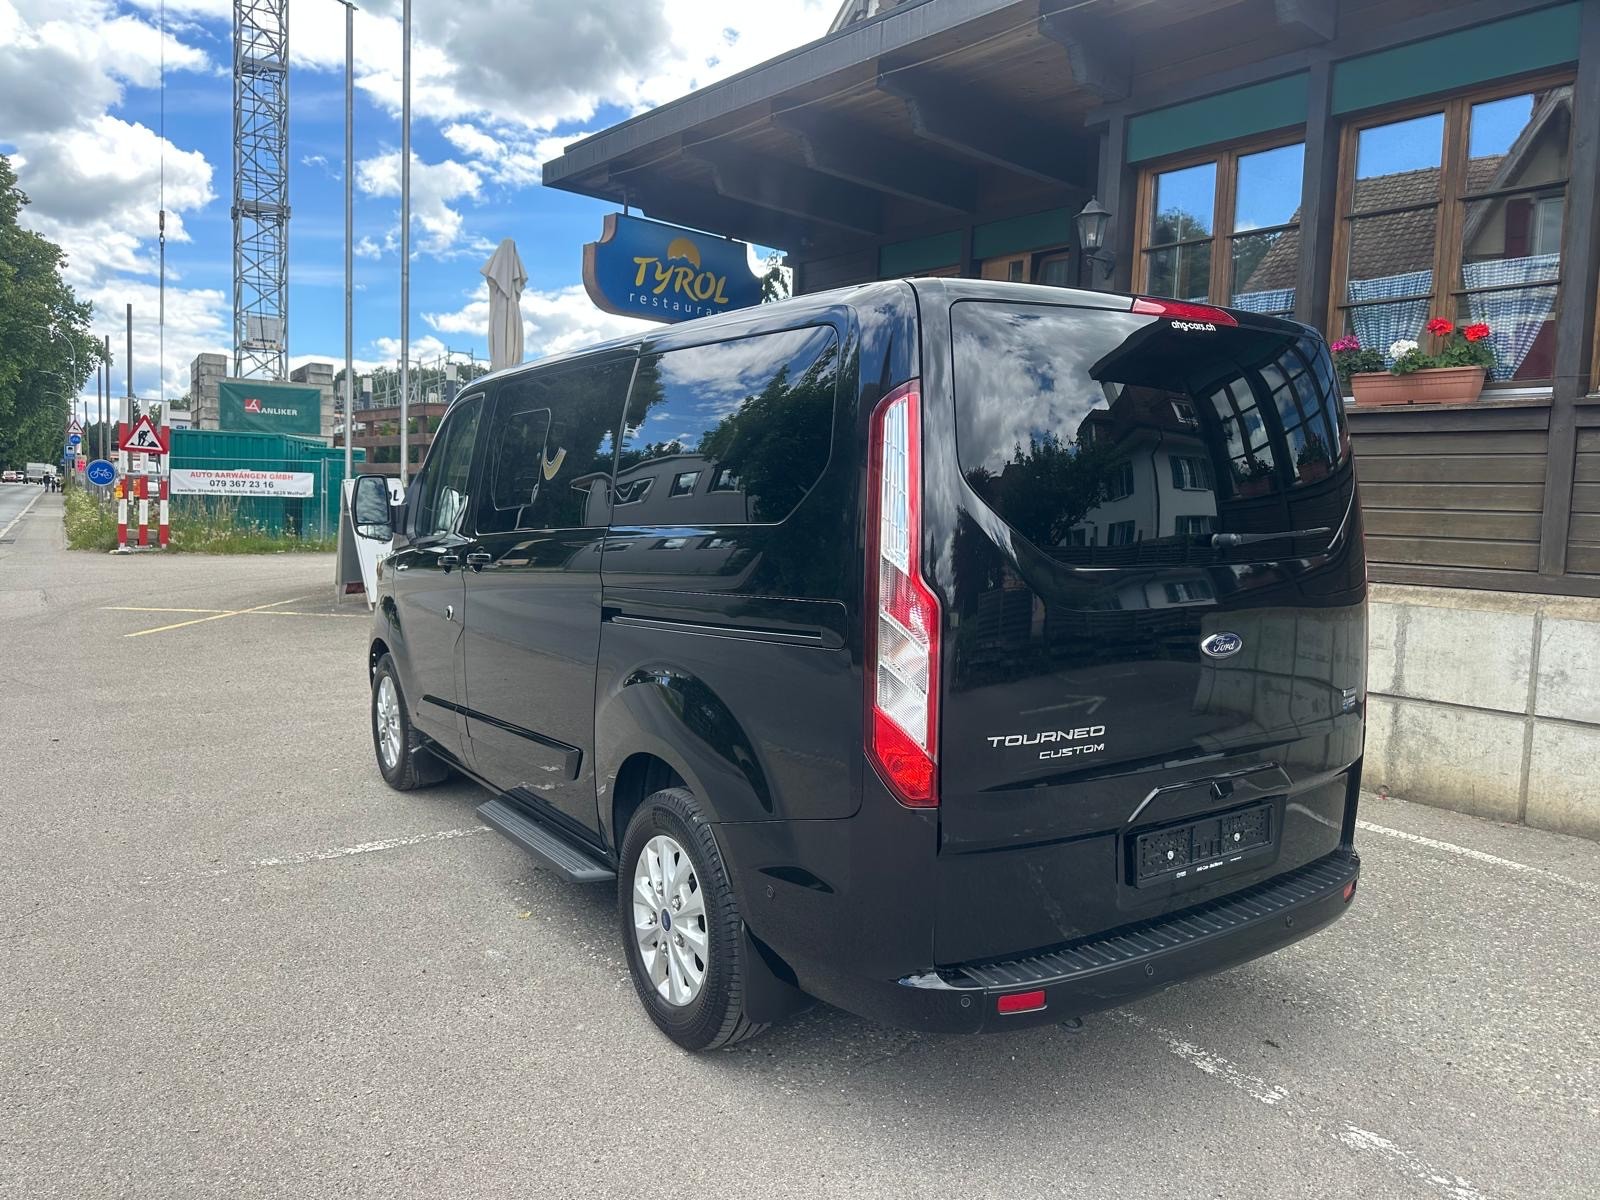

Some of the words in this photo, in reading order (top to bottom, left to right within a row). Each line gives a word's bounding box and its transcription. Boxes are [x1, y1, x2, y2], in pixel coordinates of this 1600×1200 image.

[632, 256, 729, 304] TYROL
[261, 407, 298, 416] ANLIKER
[269, 473, 294, 481] GMBH
[229, 480, 246, 488] 367
[249, 480, 260, 488] 23
[263, 481, 274, 489] 16
[987, 725, 1106, 748] TOURNEO
[1039, 743, 1105, 760] CUSTOM
